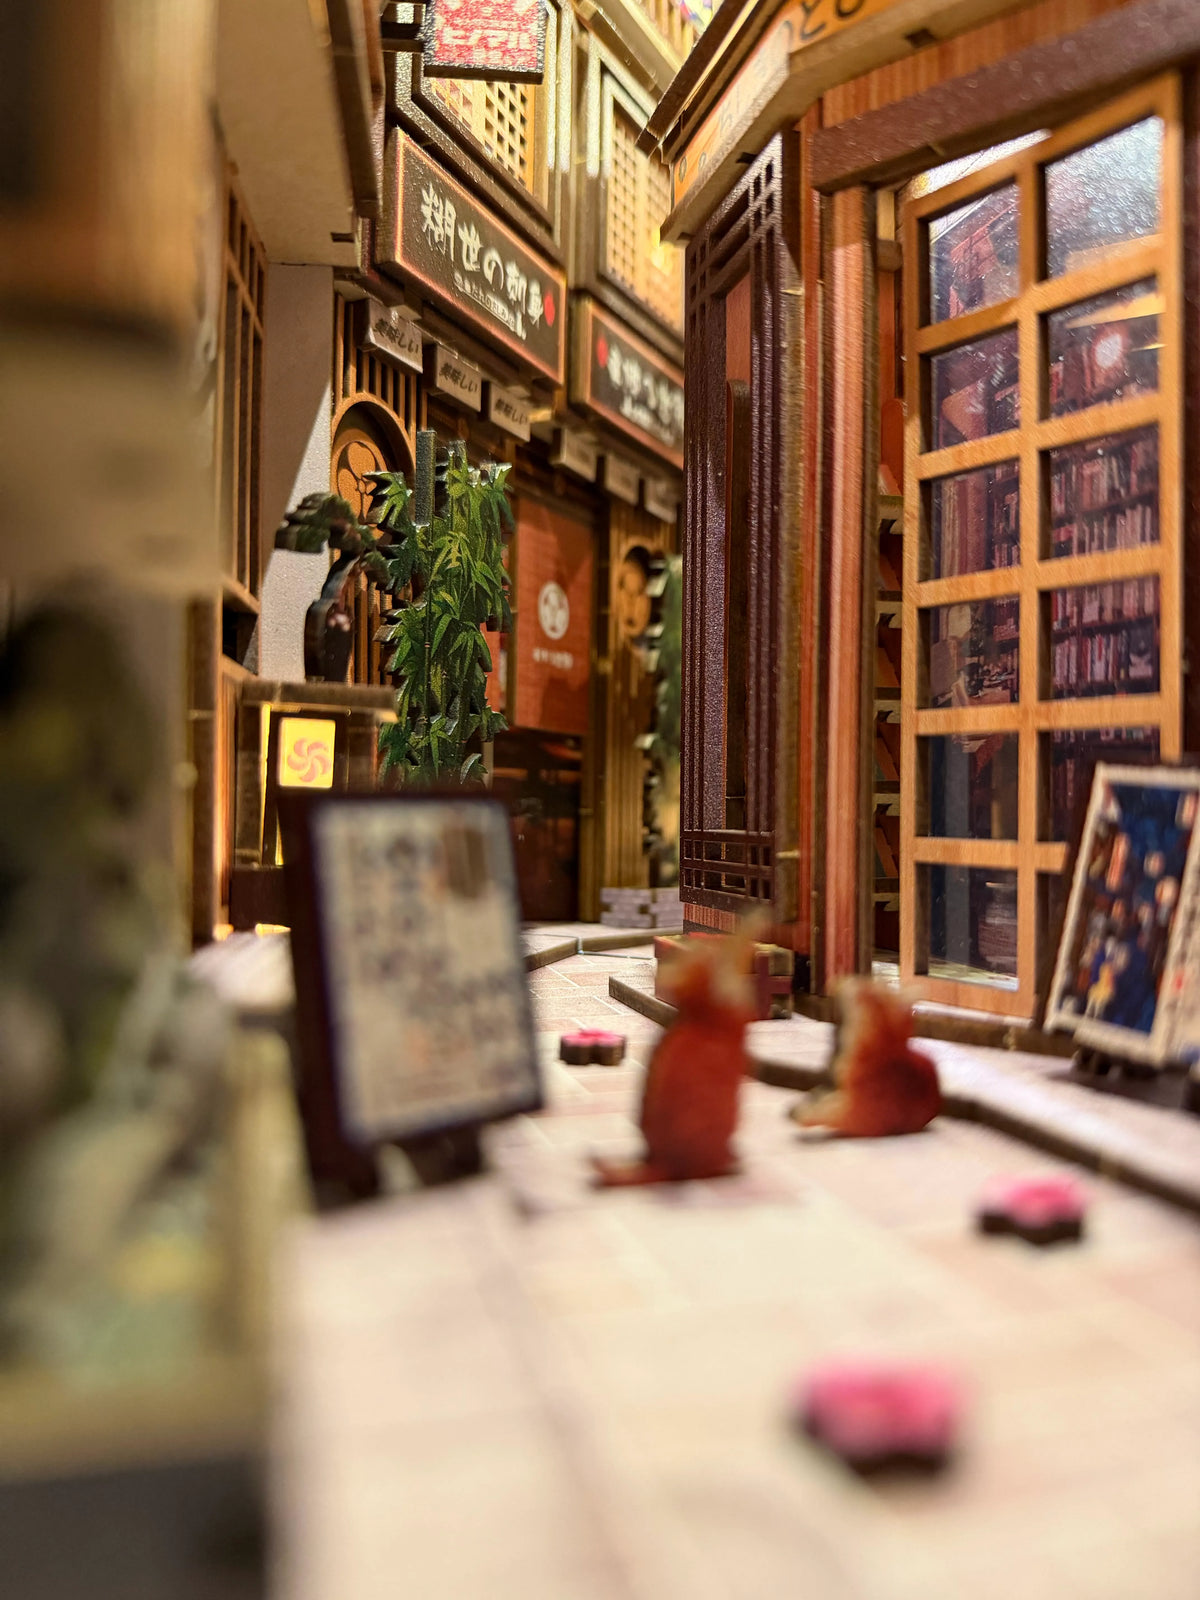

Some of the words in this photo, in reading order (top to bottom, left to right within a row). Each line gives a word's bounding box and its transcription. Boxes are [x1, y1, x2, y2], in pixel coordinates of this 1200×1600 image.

[374, 318, 419, 354] 美味しい
[438, 362, 479, 393] 美味しい
